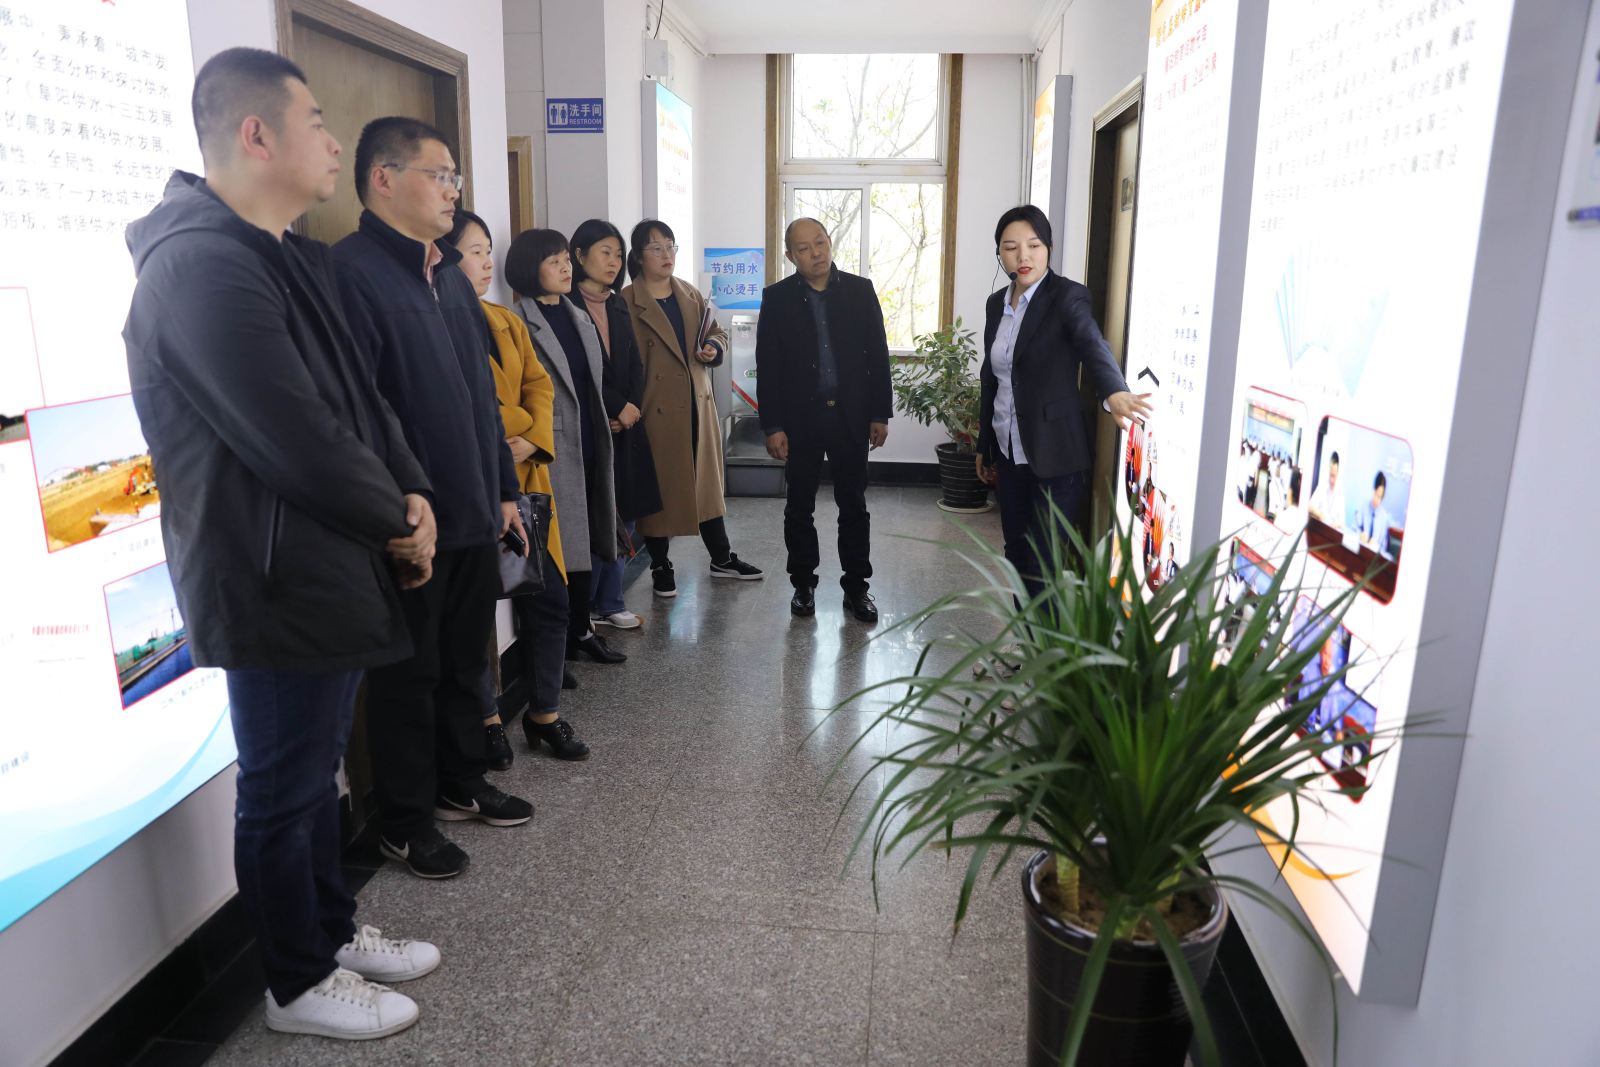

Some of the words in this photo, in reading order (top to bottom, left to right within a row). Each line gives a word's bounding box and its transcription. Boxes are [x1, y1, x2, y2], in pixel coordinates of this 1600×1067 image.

[569, 103, 602, 117] 洗手间
[710, 262, 759, 274] 节约用水
[717, 283, 759, 296] 心烫手
